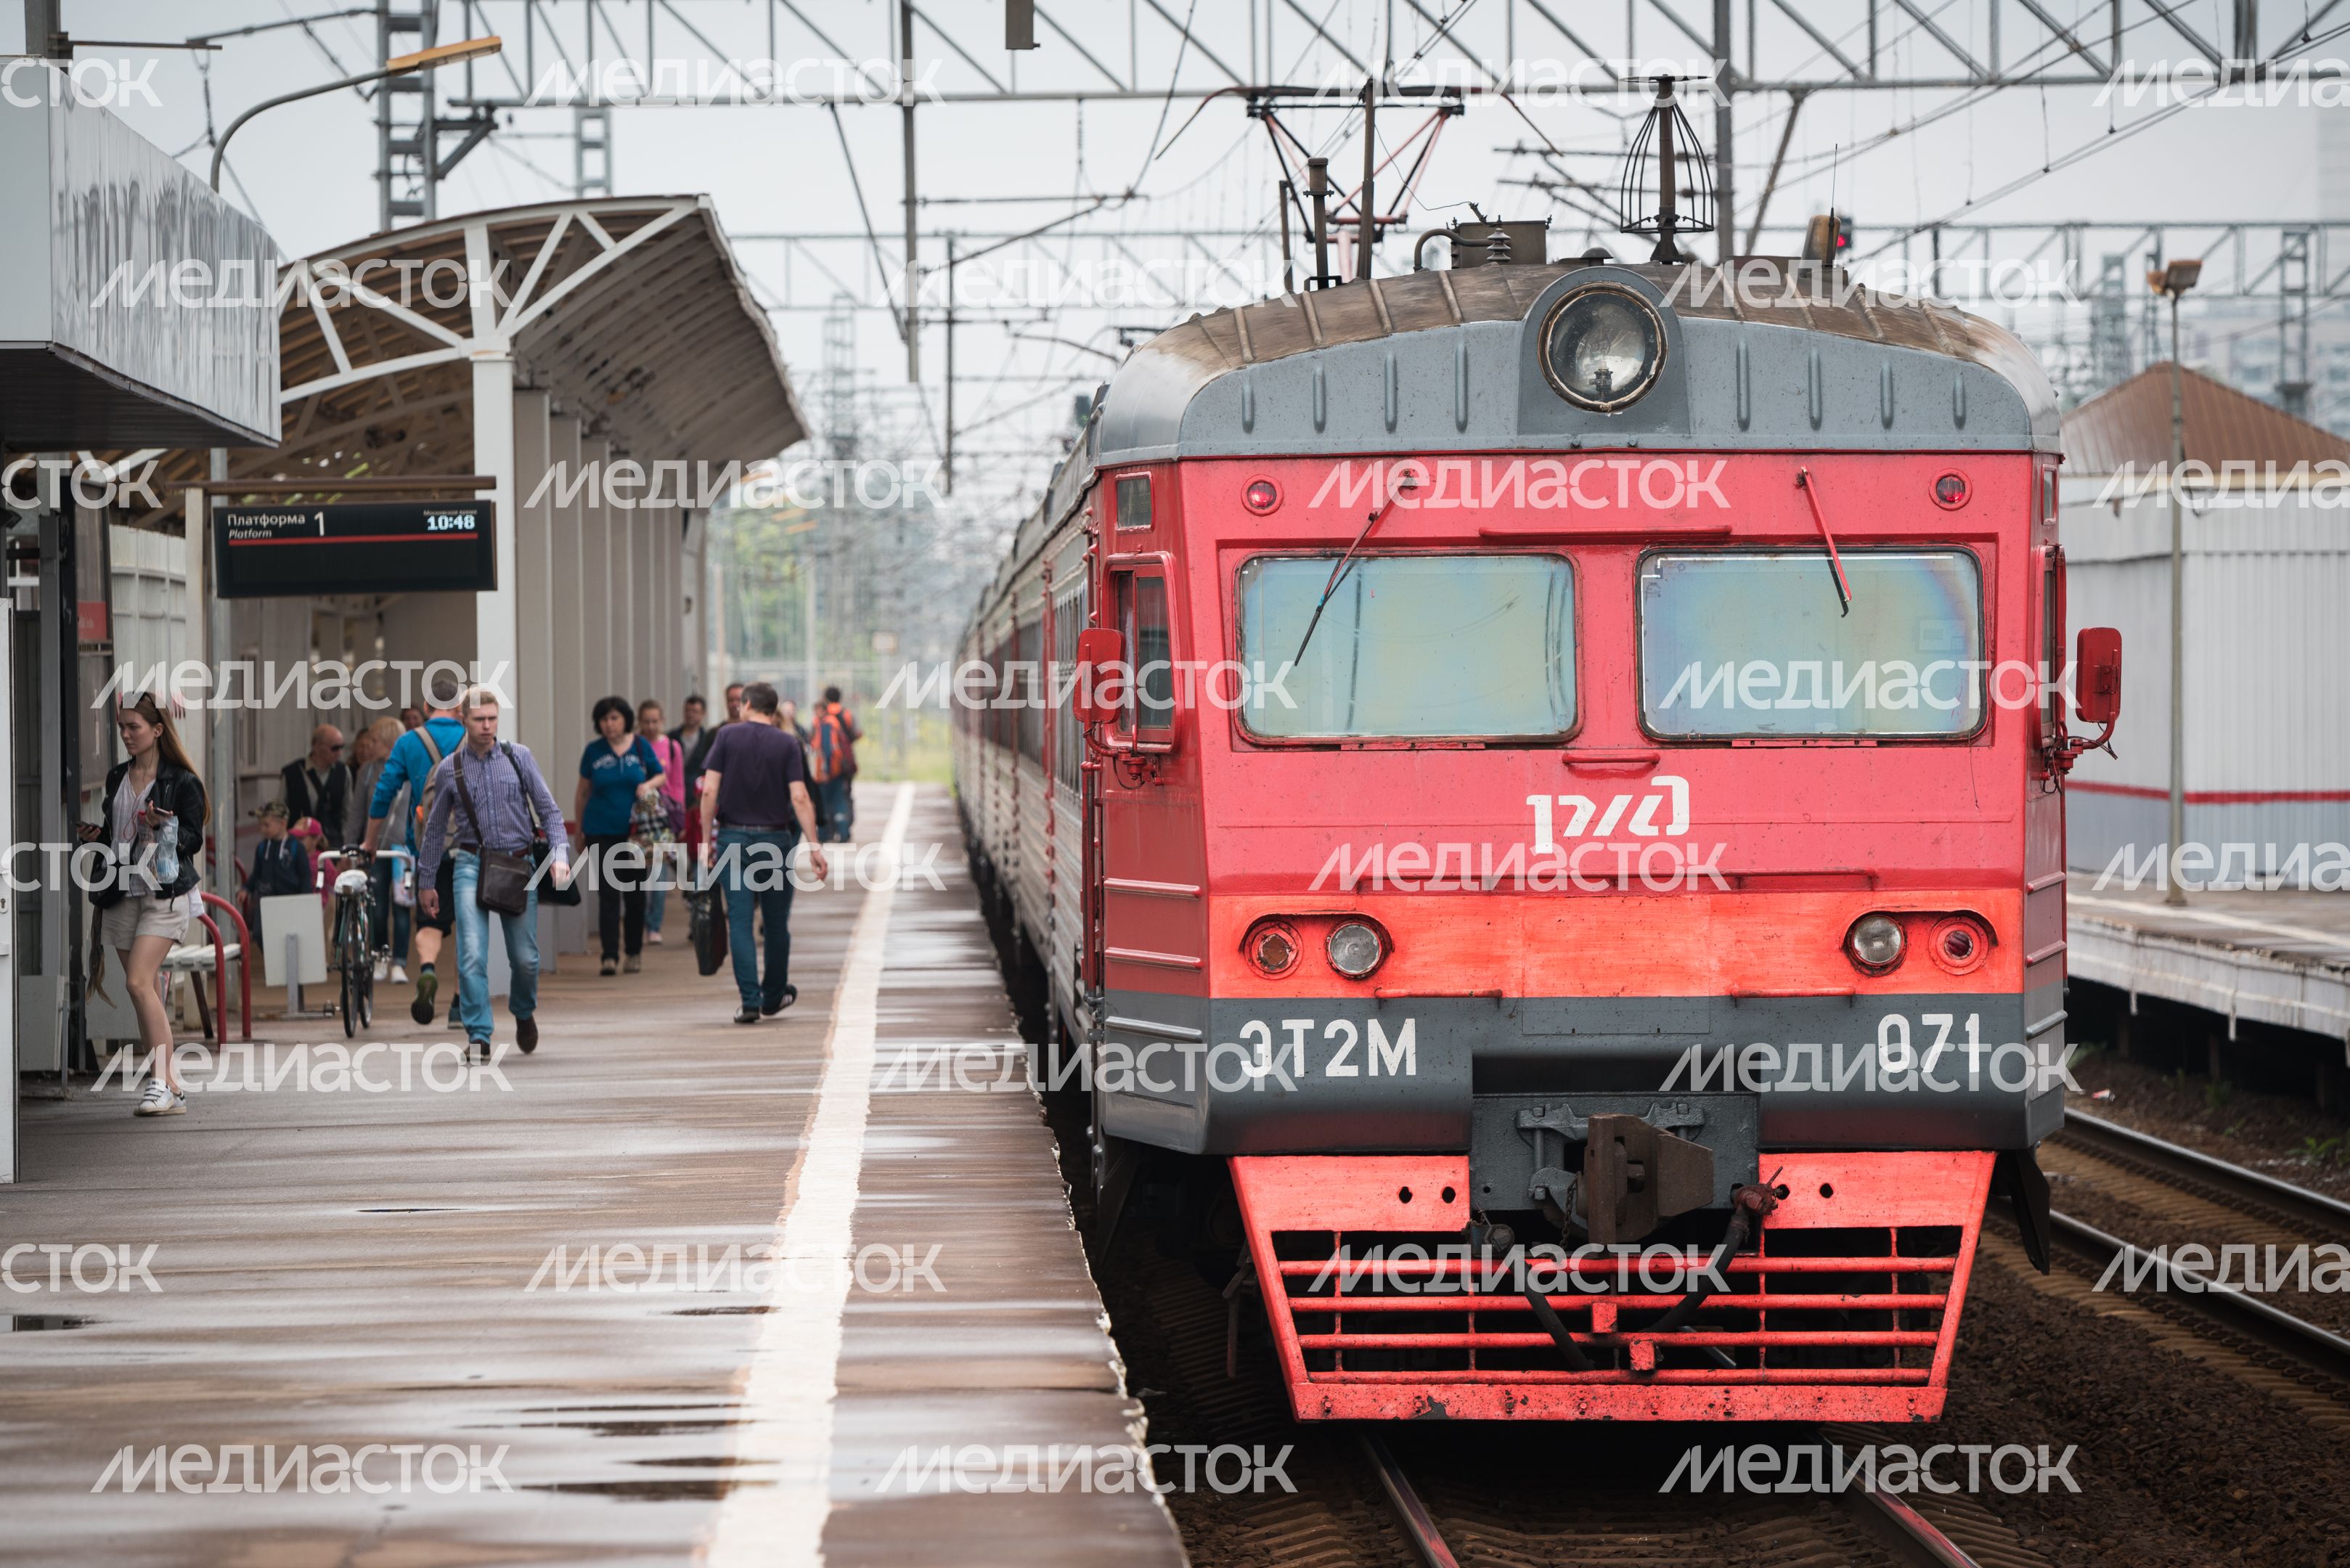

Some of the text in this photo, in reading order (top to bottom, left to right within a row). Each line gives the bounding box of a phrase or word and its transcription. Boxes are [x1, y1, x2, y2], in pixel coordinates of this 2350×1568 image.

[227, 512, 325, 536] Платформа 1
[427, 515, 476, 531] 10:48
[229, 528, 272, 539] Platform
[1877, 1013, 1980, 1074] 071
